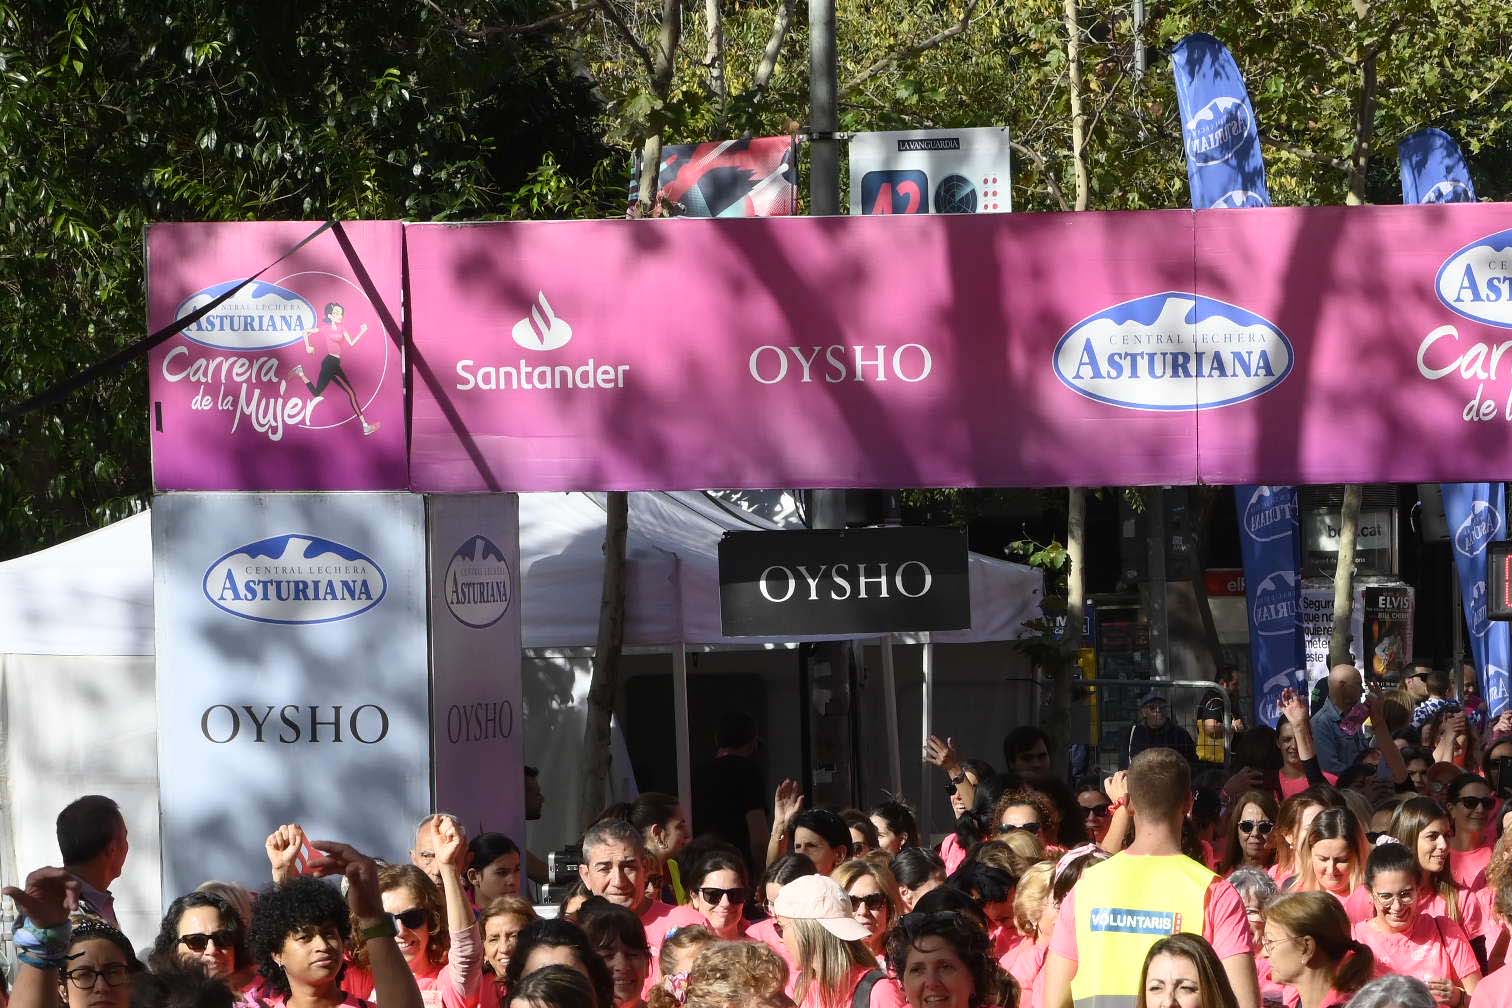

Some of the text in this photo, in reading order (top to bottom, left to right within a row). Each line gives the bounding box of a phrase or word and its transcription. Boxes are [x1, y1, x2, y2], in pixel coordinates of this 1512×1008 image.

[1109, 333, 1268, 345] CENTRAL LECHERA
[162, 346, 280, 384] Carrera
[456, 358, 630, 391] Santander
[749, 343, 934, 384] OYSHO
[1072, 341, 1276, 381] ASTURIANA
[191, 380, 325, 441] de la Mujer
[1462, 383, 1498, 423] de
[218, 568, 374, 601] ASTURIANA
[246, 566, 367, 575] CENTRAL LECHERA
[449, 571, 509, 606] ASTURIANA
[759, 560, 933, 603] OYSHO
[201, 703, 389, 744] OYSHO
[447, 700, 514, 745] OYSHO
[1092, 912, 1172, 931] VOLUNTARIS
